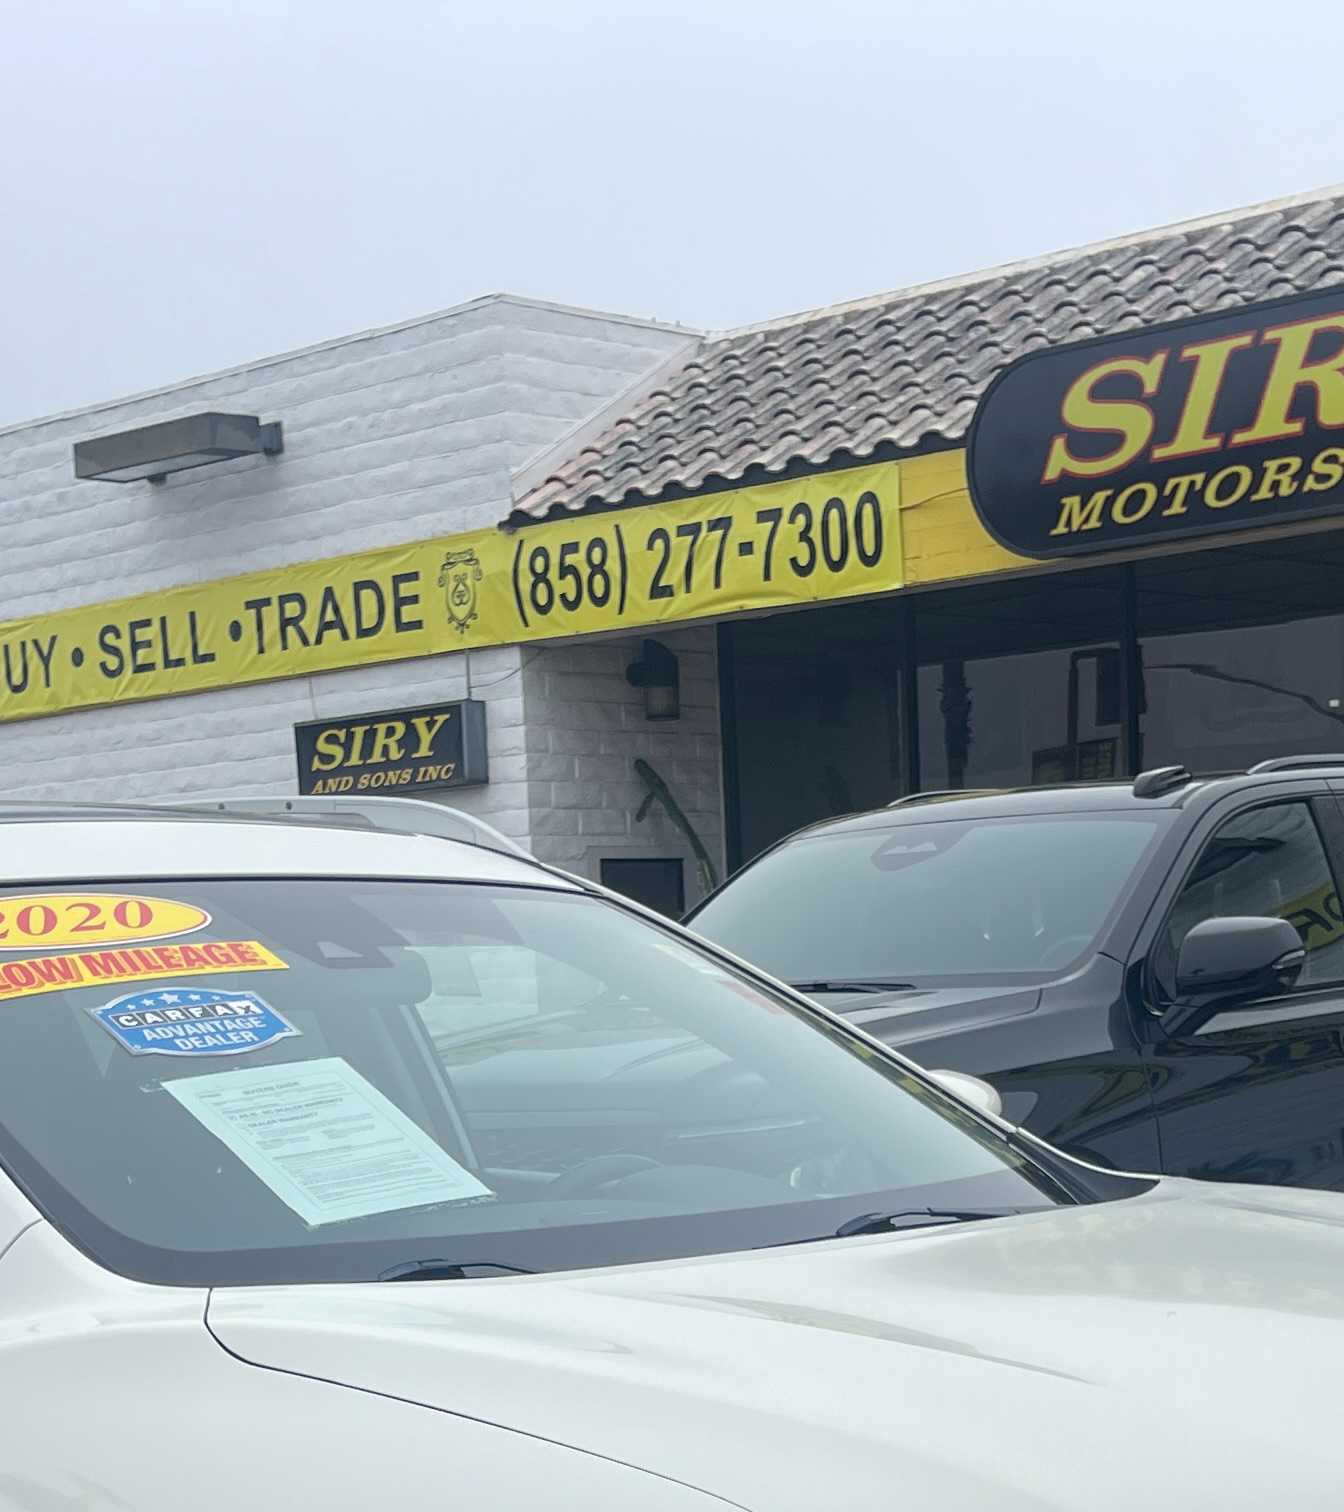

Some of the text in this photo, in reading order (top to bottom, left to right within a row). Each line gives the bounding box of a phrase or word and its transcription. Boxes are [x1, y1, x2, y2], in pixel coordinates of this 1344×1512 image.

[512, 490, 882, 627] (858) 277-7300
[98, 610, 216, 679] SELL
[245, 571, 424, 654] TRADE
[311, 714, 450, 772] SIRY
[312, 763, 455, 795] AND SONS INC
[80, 941, 269, 979] MILEAGE
[118, 1000, 264, 1027] CARFAX
[142, 1015, 267, 1041] ADVANTAGE
[174, 1031, 260, 1051] DEALER
